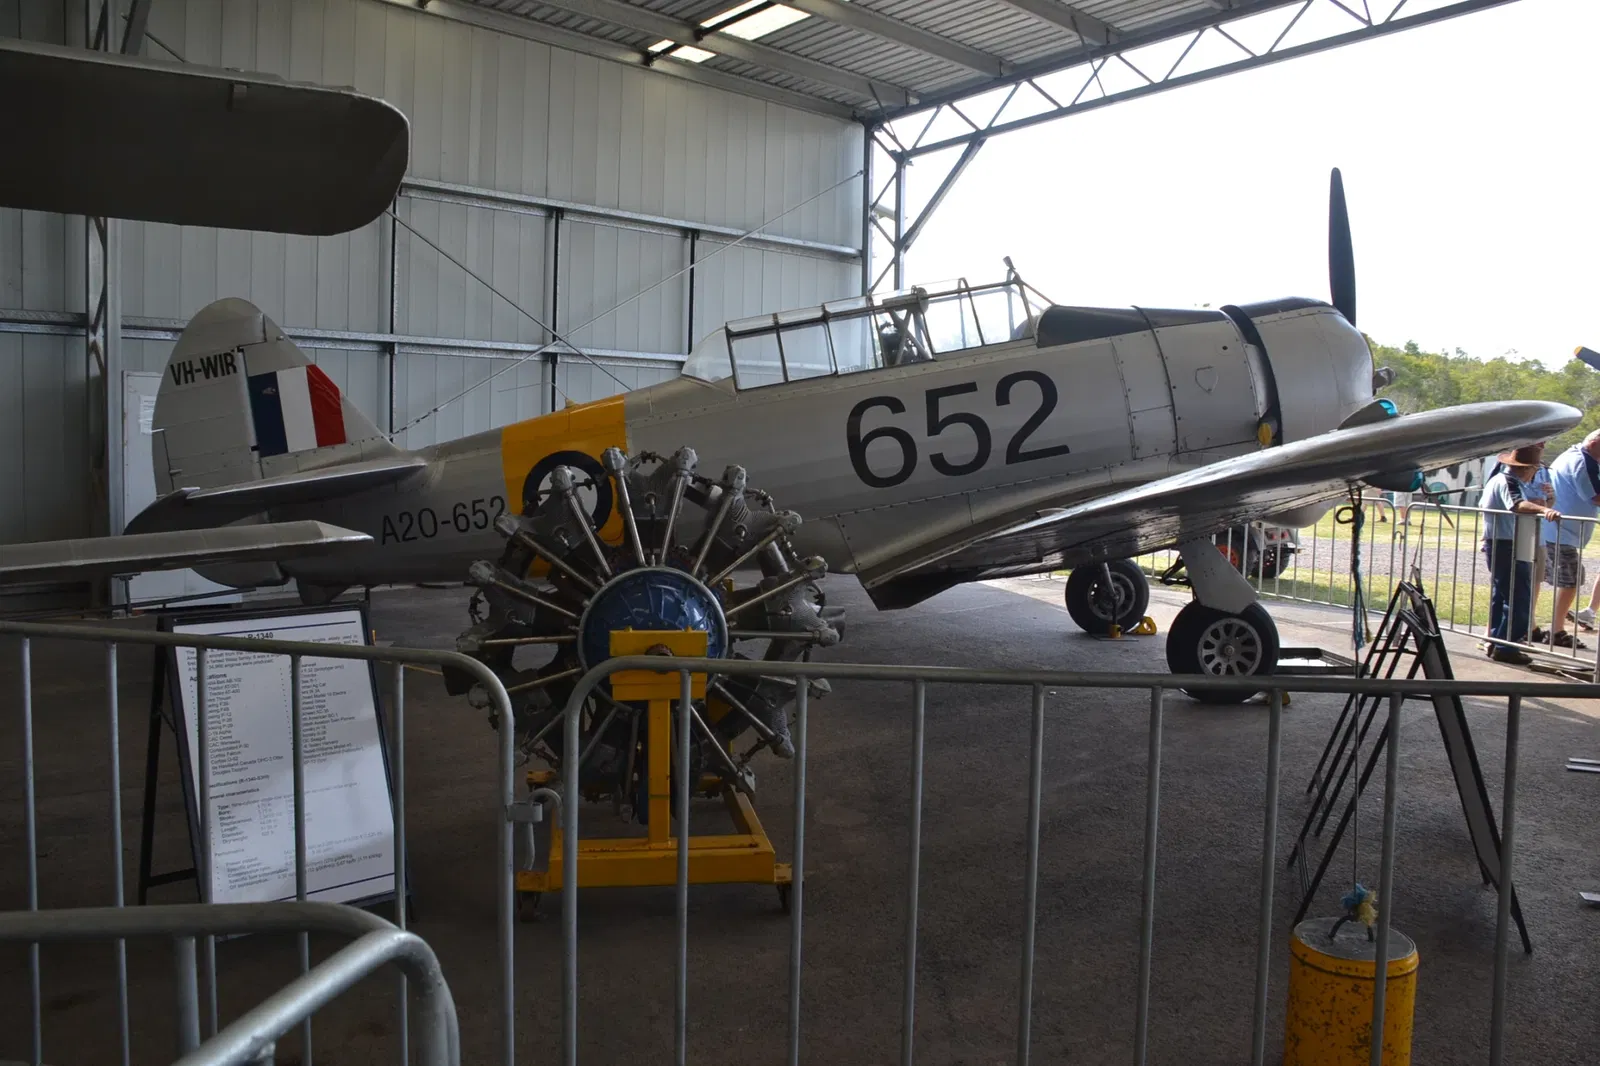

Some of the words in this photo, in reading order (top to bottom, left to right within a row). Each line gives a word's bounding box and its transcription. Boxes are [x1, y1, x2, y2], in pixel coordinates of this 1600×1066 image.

[170, 352, 237, 386] VH-WIR
[846, 370, 1070, 489] 652
[381, 495, 506, 546] A20-652
